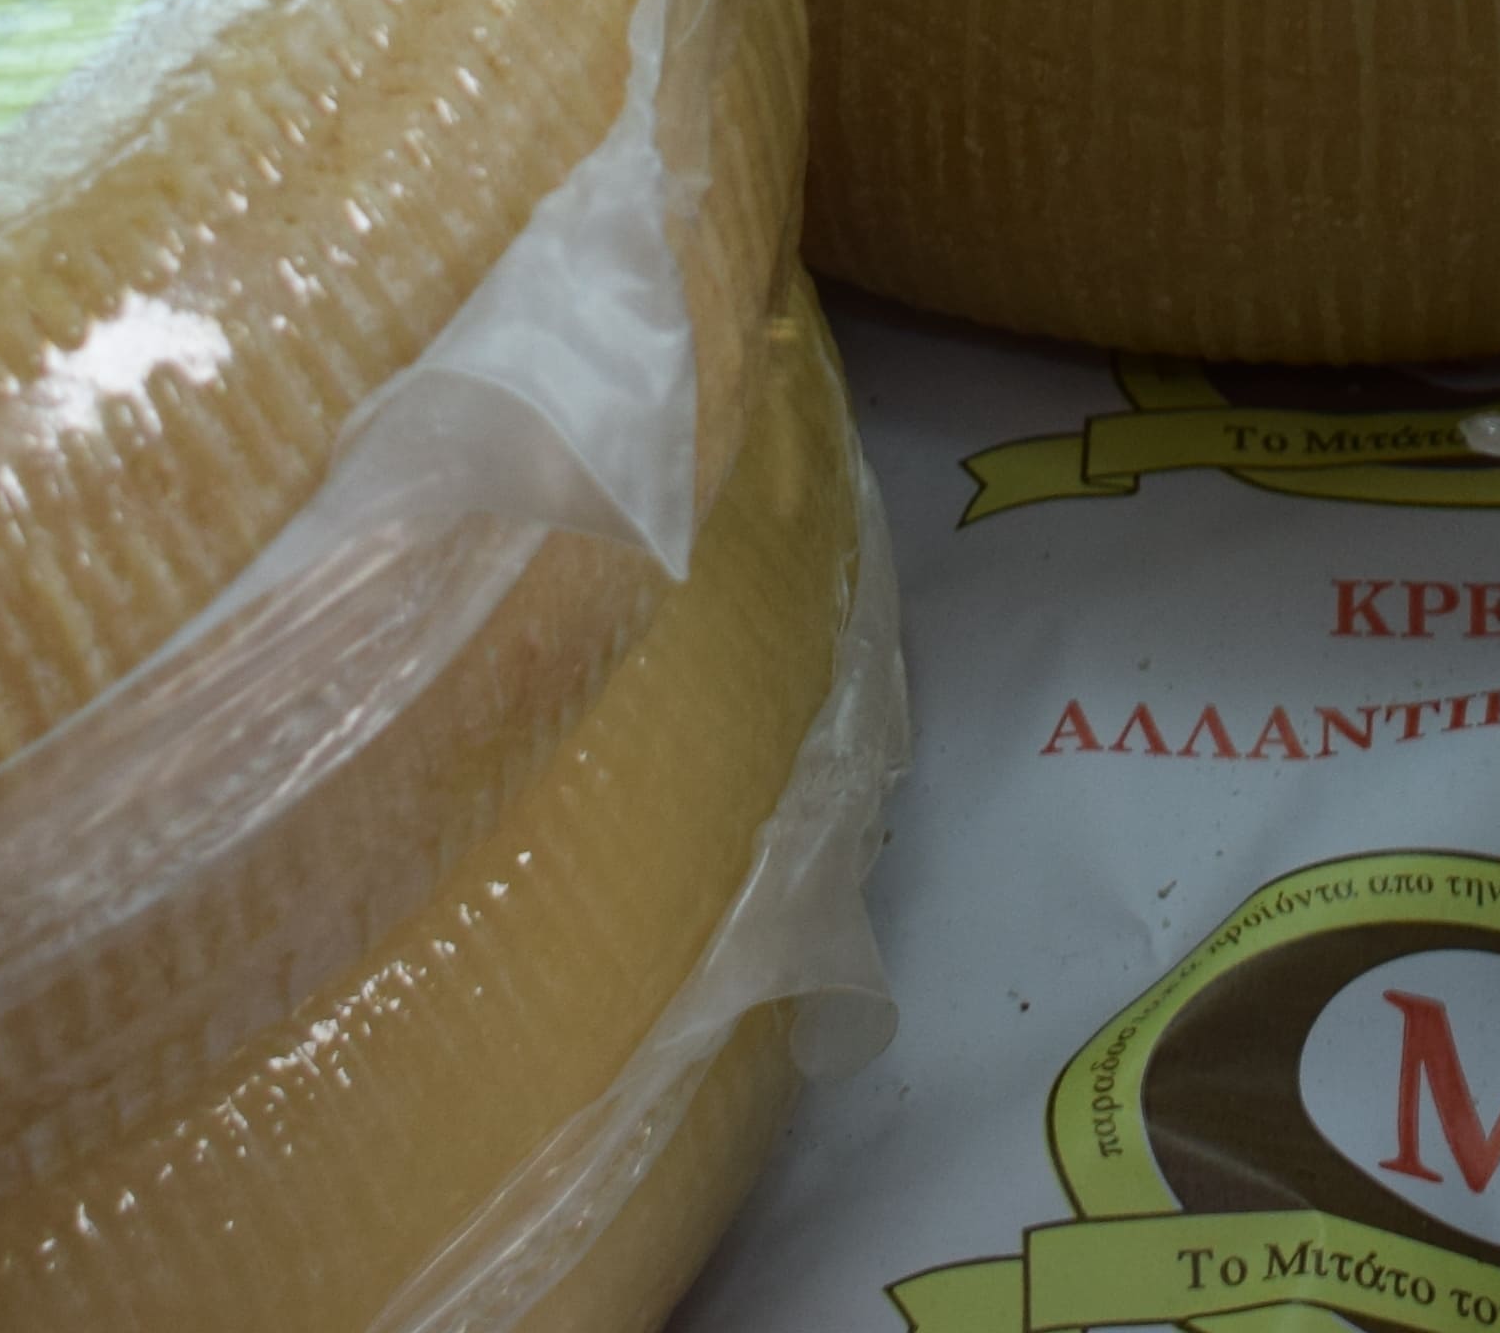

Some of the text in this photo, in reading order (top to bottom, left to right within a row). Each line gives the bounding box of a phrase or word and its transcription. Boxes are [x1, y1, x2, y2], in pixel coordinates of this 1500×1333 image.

[1224, 424, 1288, 454] Το
[1177, 1248, 1248, 1292] Το
[1262, 1239, 1437, 1307] Μιτάτο
